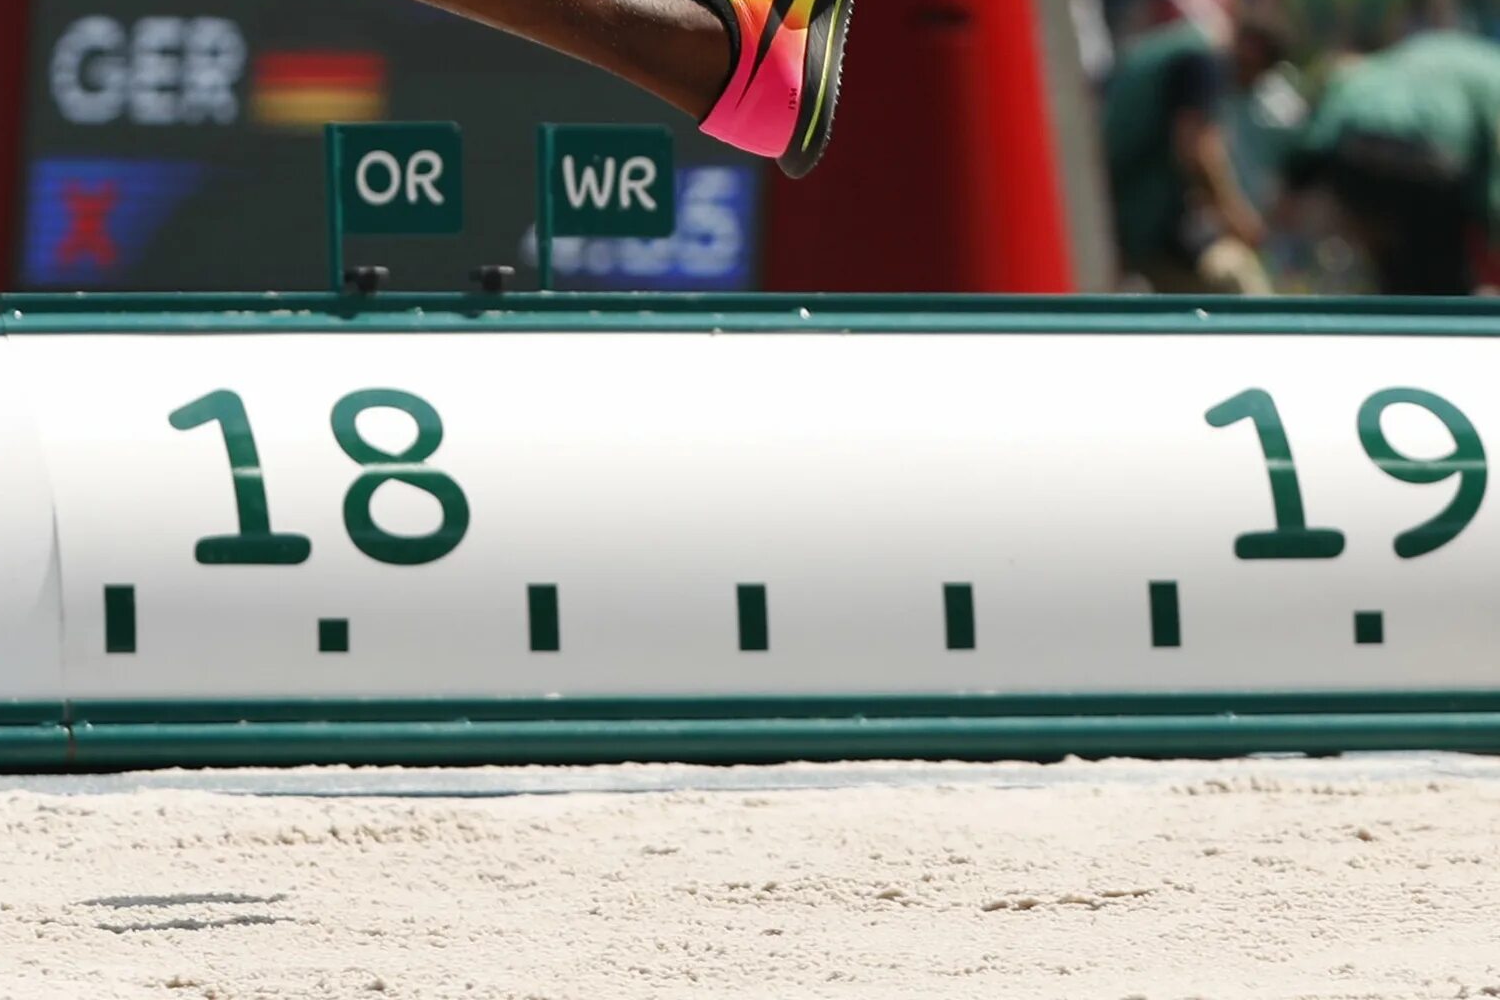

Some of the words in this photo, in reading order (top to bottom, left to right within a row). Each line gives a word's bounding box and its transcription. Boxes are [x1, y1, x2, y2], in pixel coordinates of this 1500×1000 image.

[54, 16, 246, 122] GER
[355, 150, 445, 205] OR
[562, 155, 657, 210] WR
[169, 387, 470, 565] 18
[1204, 385, 1489, 559] 19
